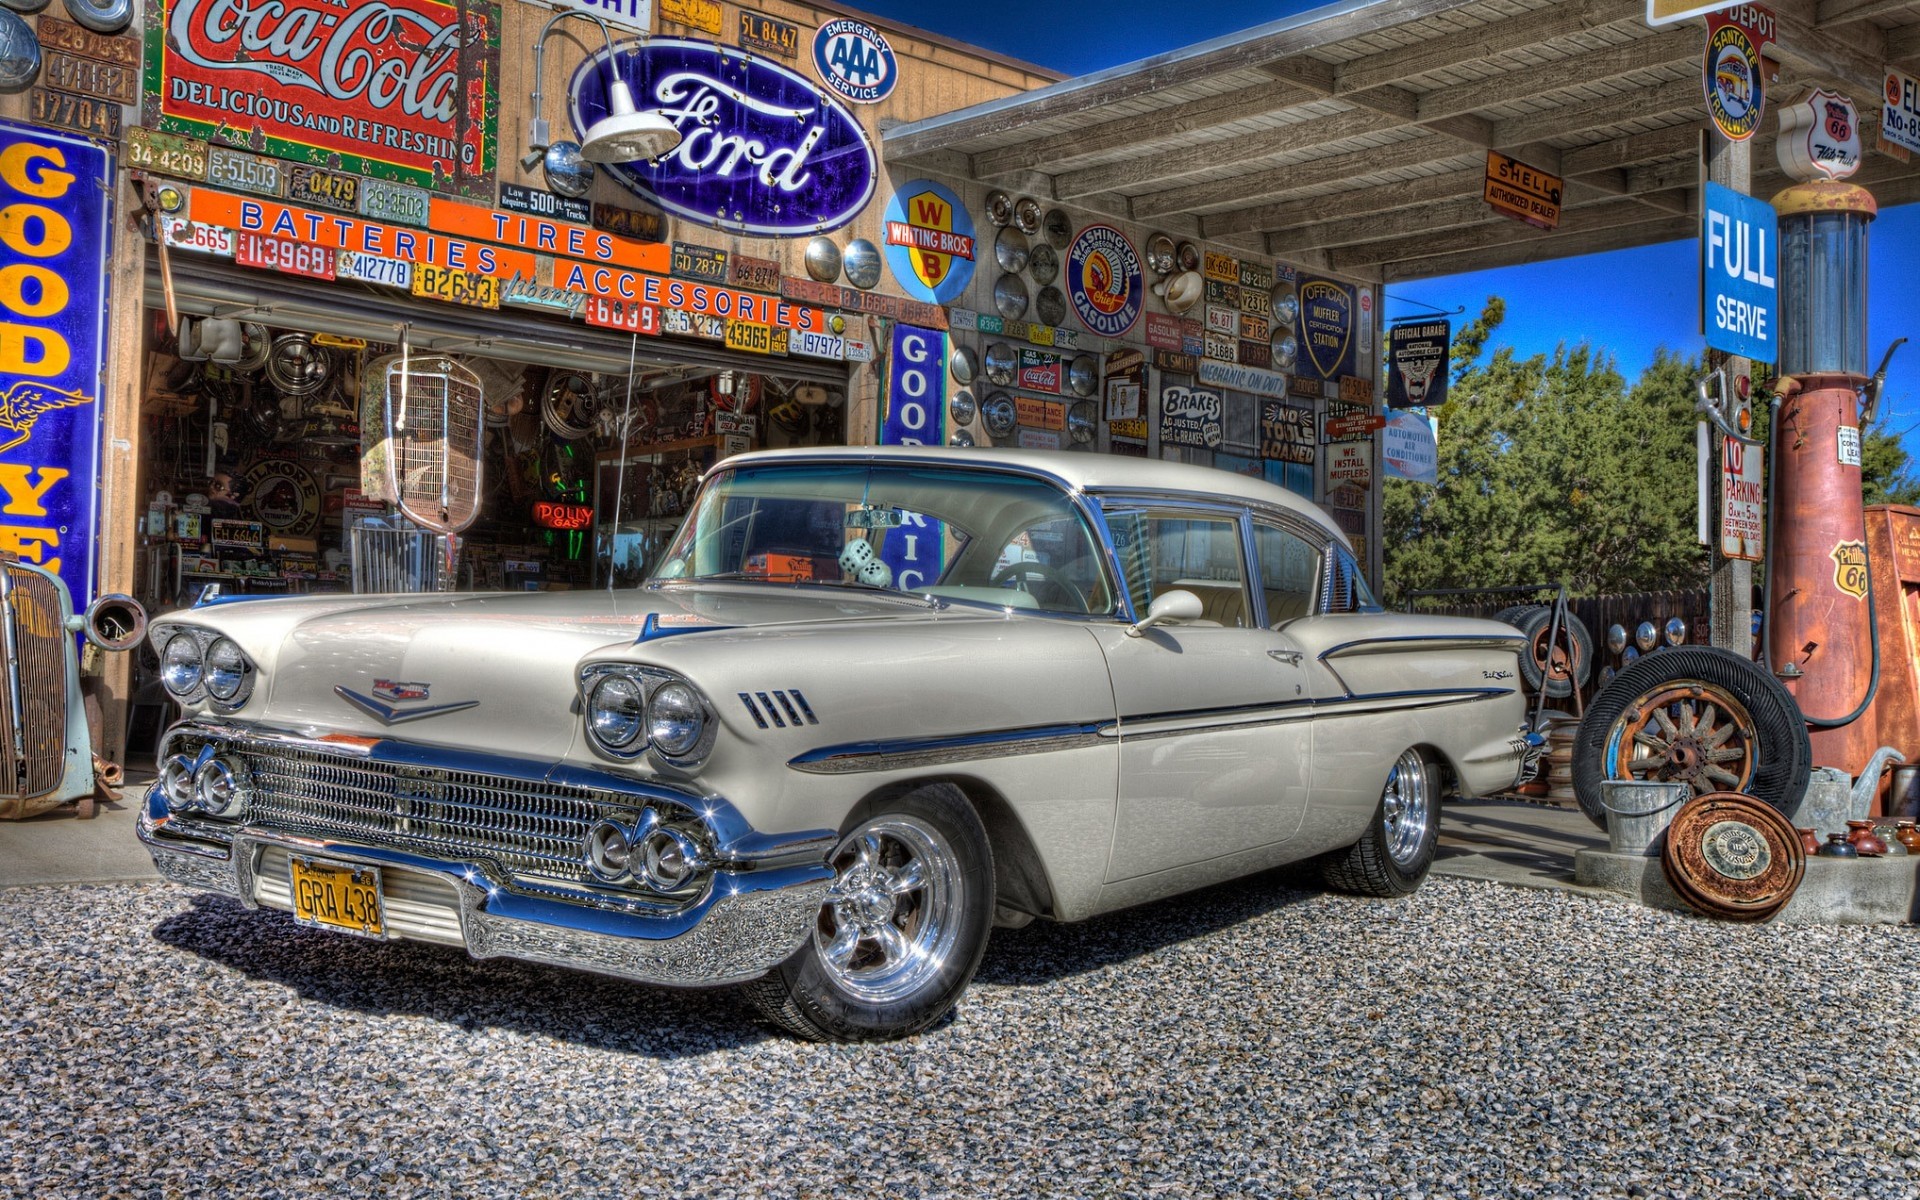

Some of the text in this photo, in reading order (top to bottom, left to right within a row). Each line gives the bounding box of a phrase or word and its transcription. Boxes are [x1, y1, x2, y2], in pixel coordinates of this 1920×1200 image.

[1728, 3, 1775, 39] DEPOT
[825, 20, 889, 54] EMERGENCY
[1713, 29, 1757, 70] SANTA FE
[170, 0, 480, 124] Coca-Cola
[265, 64, 284, 72] TRADE
[830, 35, 880, 86] AAA
[827, 72, 879, 100] SERVICE
[1888, 80, 1899, 97] 76
[171, 77, 304, 127] DELICIOUS
[304, 114, 341, 136] AND
[342, 114, 476, 165] REFRESHING
[1709, 87, 1759, 134] TRAILWAYS
[647, 73, 825, 192] Ford
[1830, 120, 1848, 138] 66
[310, 171, 355, 201] 0479
[507, 186, 524, 198] Law
[1499, 163, 1552, 197] SHELL
[501, 195, 528, 209] Requires
[530, 191, 555, 214] 500
[566, 209, 586, 221] Trucks
[916, 199, 944, 226] W
[1489, 185, 1557, 221] AUTHORIZED DEALER
[240, 200, 498, 275] BATTERIES
[491, 213, 613, 261] TIRES
[940, 231, 971, 256] BROS.
[1708, 208, 1775, 289] FULL
[249, 234, 325, 275] 113968
[674, 253, 725, 276] GD 2837
[1071, 228, 1141, 277] WASHINGTON
[340, 255, 407, 285] CAL 412778
[922, 253, 942, 279] B
[502, 269, 587, 320] Liberty
[564, 264, 814, 330] ACCESSORIES
[1093, 290, 1125, 312] Chief
[1306, 285, 1347, 310] OFFICIAL
[1073, 290, 1137, 333] GASOLINE
[1313, 306, 1340, 323] MUFFLER
[1716, 293, 1767, 341] SERVE
[728, 321, 768, 350] 43365
[1148, 323, 1180, 339] GASOLINE
[1308, 320, 1344, 334] CERTIFICATION
[1393, 324, 1447, 341] OFFICIAL GARAGE
[791, 342, 803, 351] CAL
[803, 333, 842, 358] 197972
[1313, 332, 1339, 348] STATION
[1408, 342, 1430, 350] NATIONAL
[1022, 356, 1040, 366] TODAY
[1025, 350, 1037, 359] GAS
[1170, 353, 1194, 372] SMITH
[1023, 367, 1056, 387] Coca-Cola
[1200, 363, 1284, 392] MECHANIC ON DUTY
[1017, 402, 1062, 418] NO ADMITTANCE
[1165, 389, 1219, 417] BRAKES
[1278, 407, 1298, 424] NO
[1162, 415, 1205, 431] ADJUSTED!
[1261, 419, 1315, 446] TOOLS
[1180, 429, 1203, 446] BRAKES
[1388, 428, 1431, 444] AUTOMOTIVE
[1404, 441, 1416, 451] AIR
[1261, 439, 1315, 464] LOANED
[1334, 458, 1365, 469] INSTALL
[1342, 447, 1356, 457] WE
[1386, 447, 1432, 464] CONDITIONER
[1725, 438, 1742, 471] NO
[1330, 468, 1370, 480] MUFFLERS
[1725, 478, 1761, 505] PARKING
[539, 504, 594, 525] POLLY
[553, 518, 580, 528] GAS
[1724, 517, 1748, 529] BETWEEN
[1845, 566, 1866, 591] 66
[1720, 830, 1753, 843] HUDSON
[299, 877, 379, 926] GRA 438
